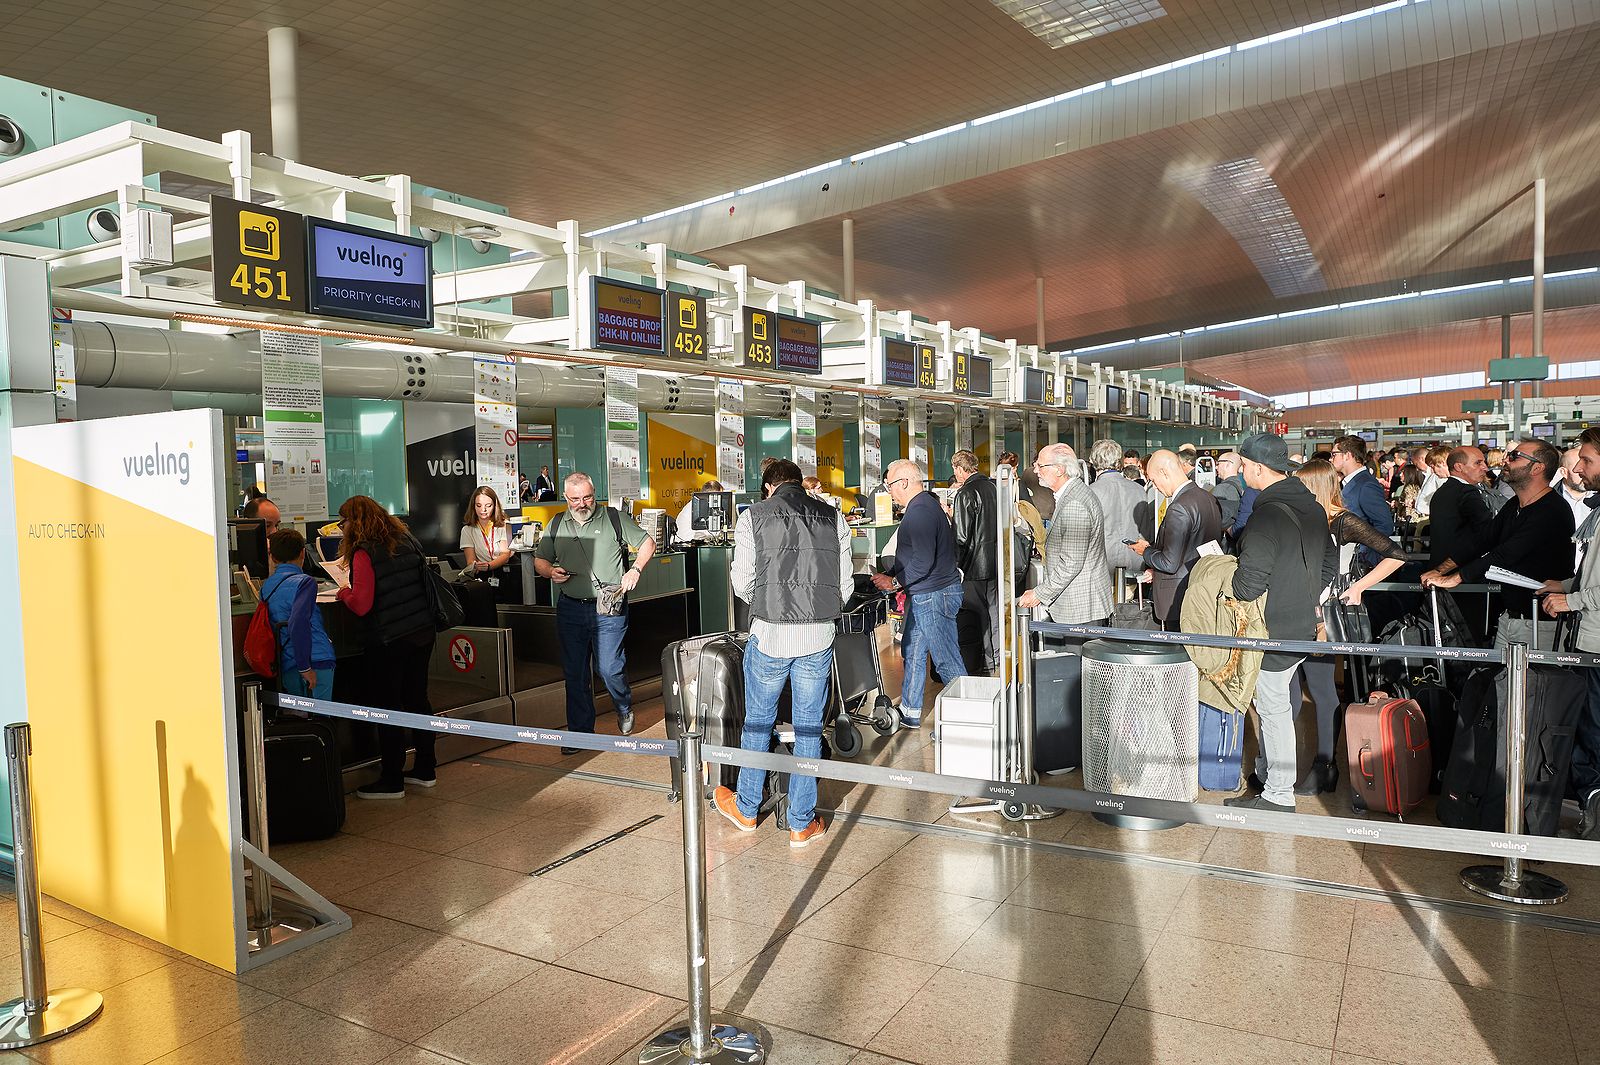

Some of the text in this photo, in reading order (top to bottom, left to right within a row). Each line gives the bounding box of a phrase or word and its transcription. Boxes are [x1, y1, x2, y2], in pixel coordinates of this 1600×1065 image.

[337, 245, 403, 277] vueling
[230, 263, 291, 302] 451
[323, 286, 421, 309] PRIORITY CHECK-IN
[599, 313, 661, 332] BAGGAGE DROP
[599, 328, 661, 345] CHK-IN ONLINE
[675, 332, 703, 355] 452
[748, 343, 772, 364] 453
[779, 341, 818, 356] BAGGAGE DROP
[779, 352, 818, 367] CHK-IN ONLINE
[920, 372, 934, 386] 454
[955, 377, 967, 391] 455
[123, 441, 190, 486] vueling
[427, 450, 475, 477] vueli
[661, 450, 704, 475] vueling
[816, 450, 836, 471] eling
[661, 489, 679, 498] LOVE
[681, 488, 693, 497] THE
[28, 523, 105, 539] AUTO CHECK-IN
[1331, 644, 1353, 653] vueling
[1435, 650, 1459, 659] vueling
[1556, 655, 1580, 664] vueling
[517, 730, 563, 741] vueling PRIORITY
[614, 740, 665, 751] vueling PRIORITY
[711, 749, 732, 760] vueling
[796, 761, 818, 773] vueling
[888, 773, 912, 784] vueling
[989, 783, 1016, 797] vueling
[1095, 799, 1124, 811] vueling
[1215, 811, 1246, 824] vueling
[1346, 825, 1381, 838] vueling
[1489, 839, 1528, 852] vueling
